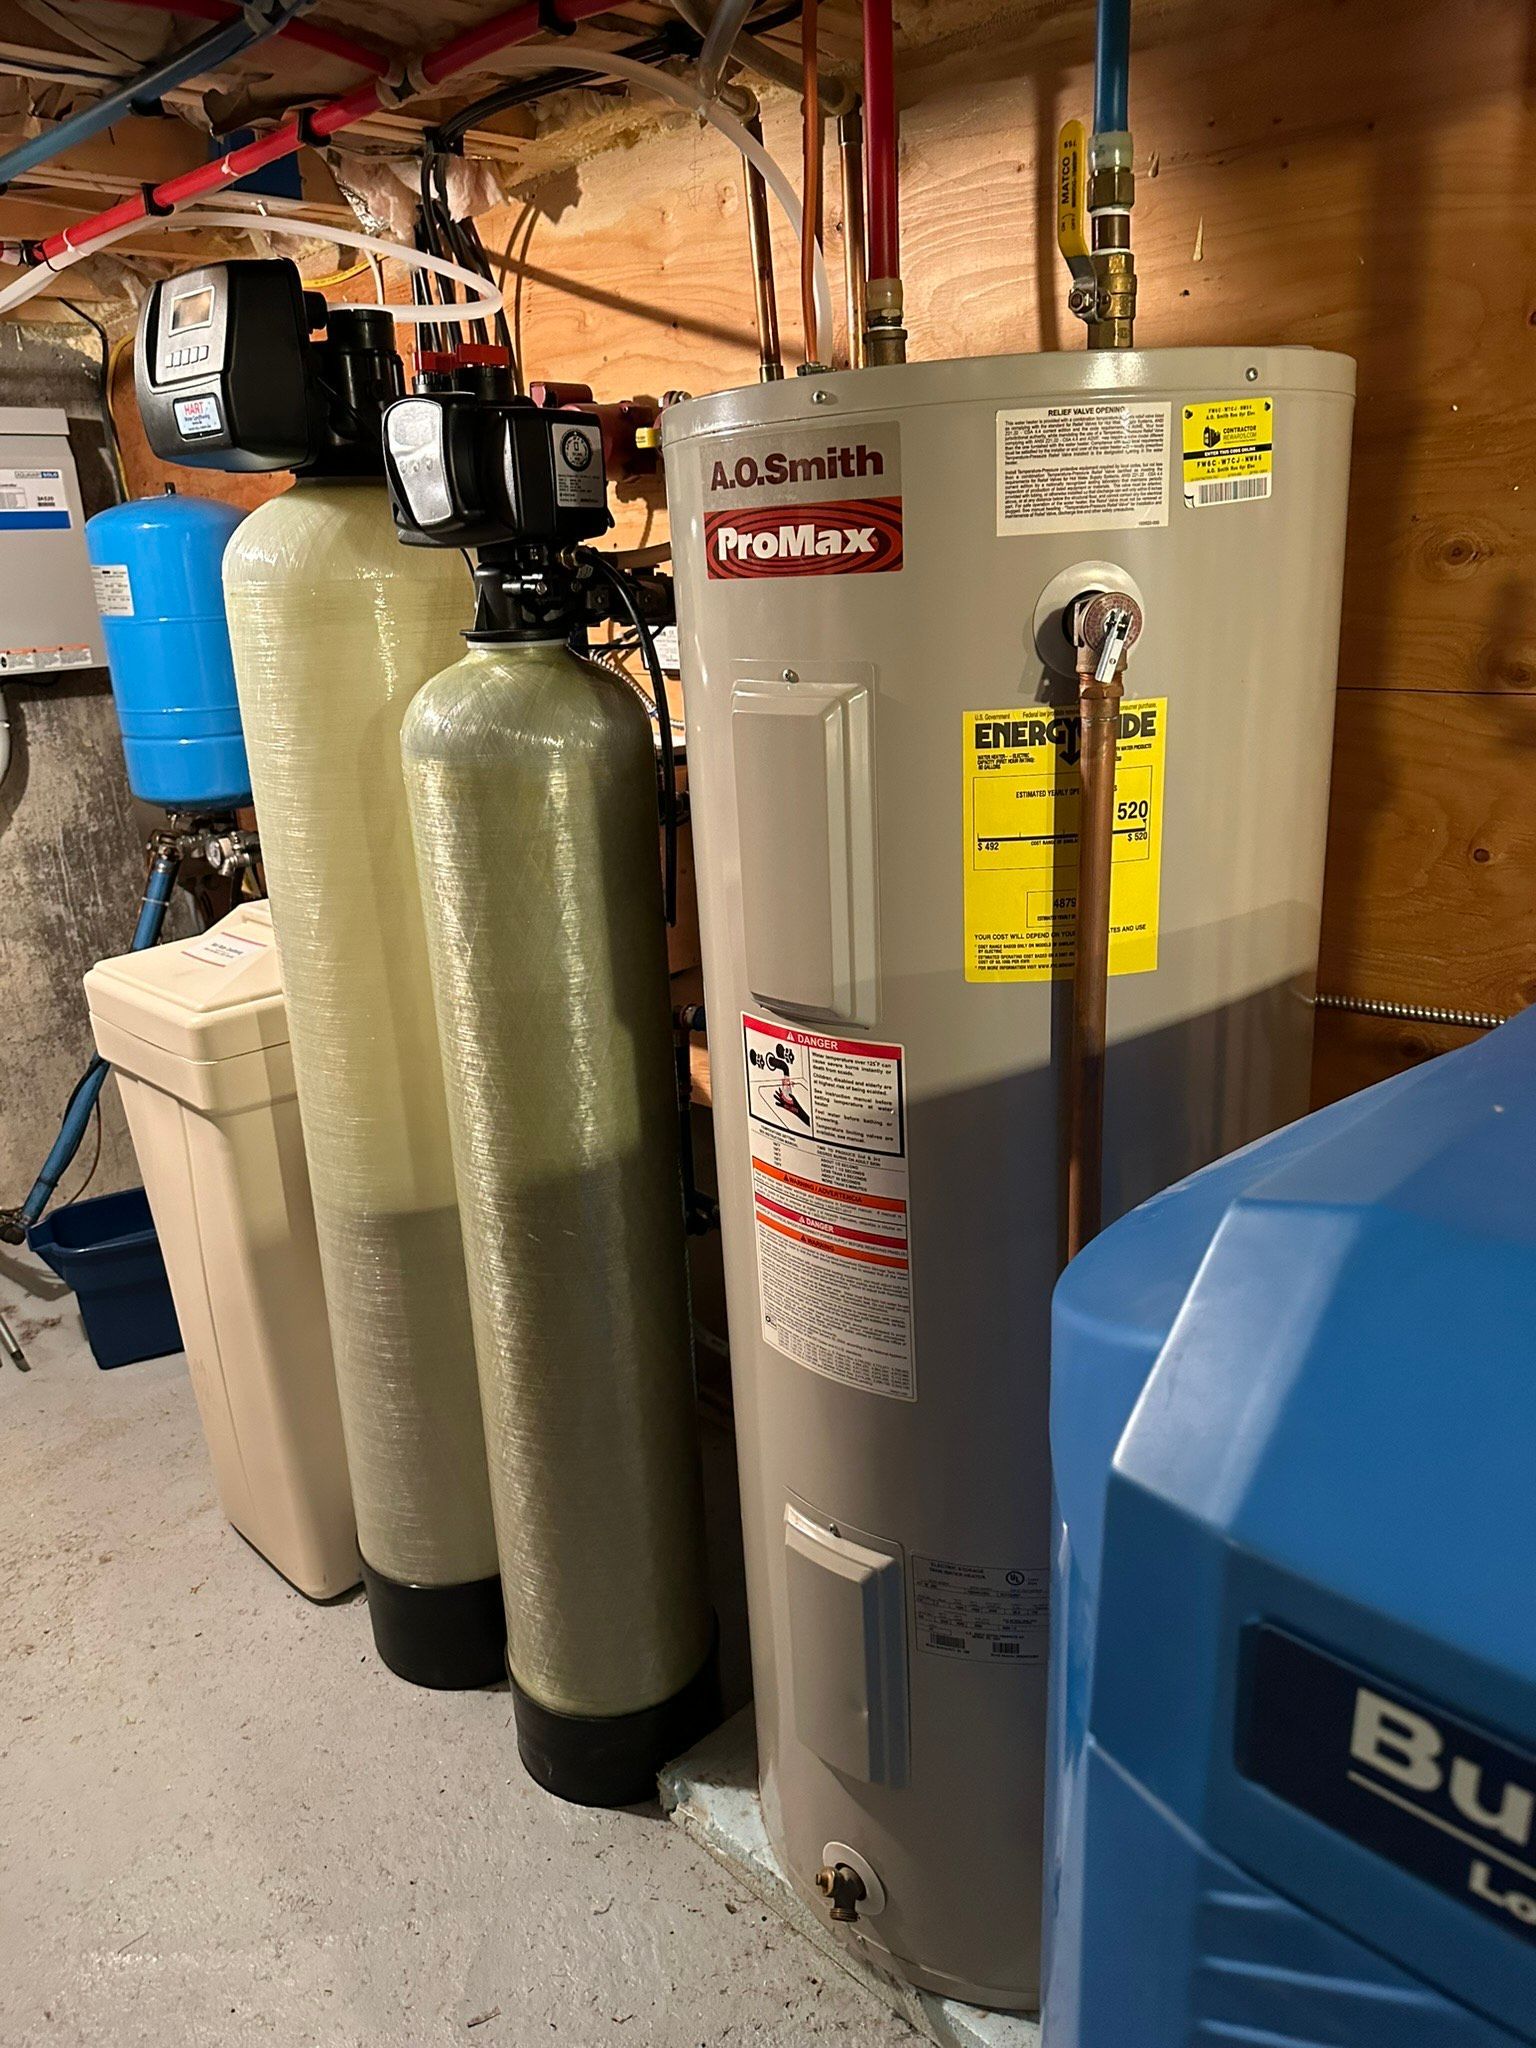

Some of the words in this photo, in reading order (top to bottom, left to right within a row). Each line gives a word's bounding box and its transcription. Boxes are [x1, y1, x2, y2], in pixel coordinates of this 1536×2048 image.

[1062, 157, 1070, 204] MATCO
[184, 402, 203, 415] HART
[1223, 425, 1256, 434] CONTRACTOR
[718, 524, 876, 561] ProMax
[1048, 789, 1068, 797] YEARLY
[1118, 800, 1148, 820] 520
[1127, 833, 1132, 842] $
[1135, 832, 1148, 841] 520
[978, 842, 982, 851] $
[985, 842, 999, 850] 492
[1053, 898, 1076, 908] 4879
[798, 1034, 838, 1050] DANGER
[826, 1055, 853, 1064] temperature
[826, 1091, 850, 1100] instruction
[834, 1099, 863, 1108] temperature
[788, 1177, 814, 1190] WARNING
[806, 1218, 834, 1233] DANGER
[808, 1238, 835, 1252] WARNING
